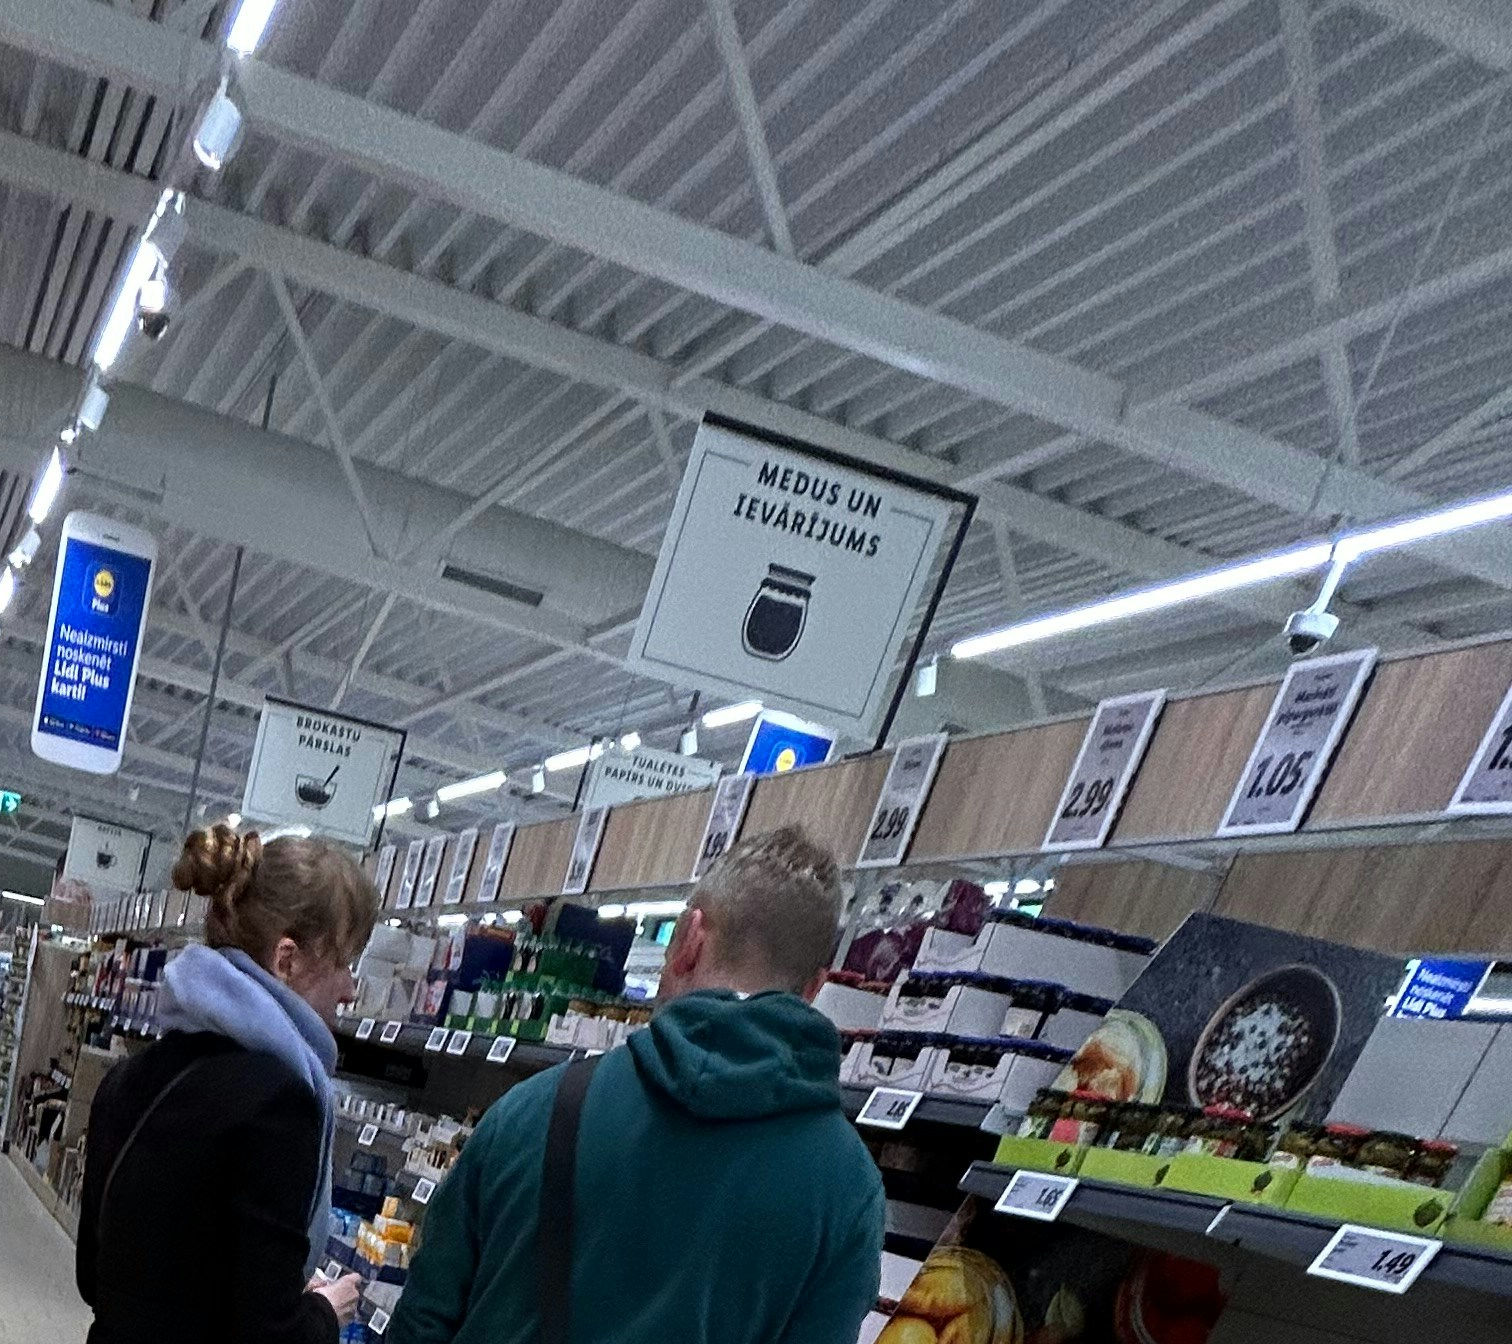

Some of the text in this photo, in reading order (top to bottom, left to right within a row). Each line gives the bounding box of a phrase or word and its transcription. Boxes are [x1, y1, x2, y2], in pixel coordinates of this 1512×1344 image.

[757, 459, 882, 519] MEDUS UN
[733, 493, 881, 557] IEVĀRĪJUMS
[81, 666, 110, 690] Plus
[296, 715, 361, 743] BROKASTU
[632, 755, 686, 778] TUALETES
[1246, 750, 1315, 799] 1.05
[647, 775, 664, 790] UN
[1060, 776, 1114, 819] 2.99
[870, 805, 910, 840] 2.99
[1370, 1248, 1417, 1275] 1.49
